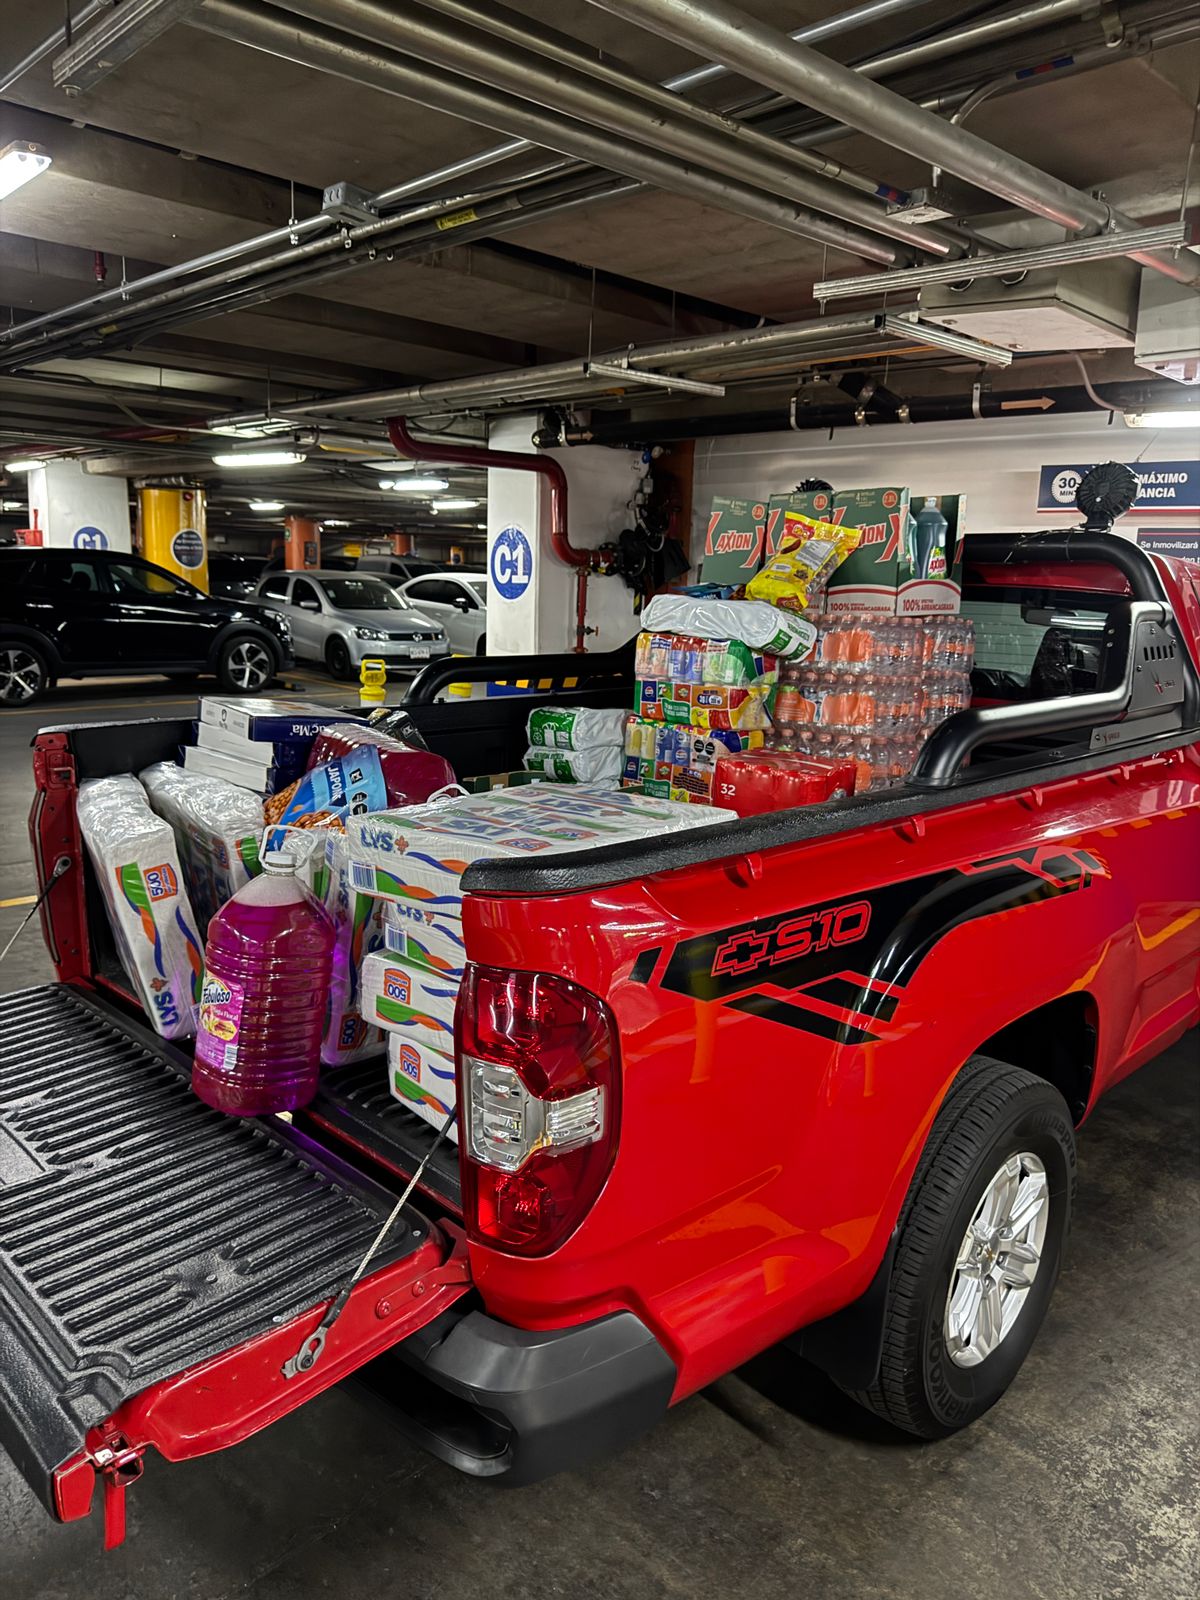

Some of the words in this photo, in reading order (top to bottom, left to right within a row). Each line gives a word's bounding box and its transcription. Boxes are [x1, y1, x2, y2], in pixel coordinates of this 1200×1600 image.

[1058, 477, 1077, 489] 30
[1138, 472, 1188, 484] MÁXIMO
[1137, 487, 1176, 498] ANCIA
[714, 530, 753, 553] AXION
[855, 522, 886, 548] ION
[1140, 541, 1151, 549] Se
[494, 543, 528, 584] C1
[830, 602, 849, 611] 100%
[903, 599, 920, 611] 100%
[720, 783, 736, 796] 32
[360, 825, 393, 851] LYS
[146, 872, 164, 897] 500
[771, 901, 871, 965] S10
[203, 986, 231, 1004] Fabuloso
[387, 983, 406, 1001] 500
[153, 990, 179, 1026] LYS
[342, 1018, 356, 1045] 500
[403, 1060, 418, 1078] 500
